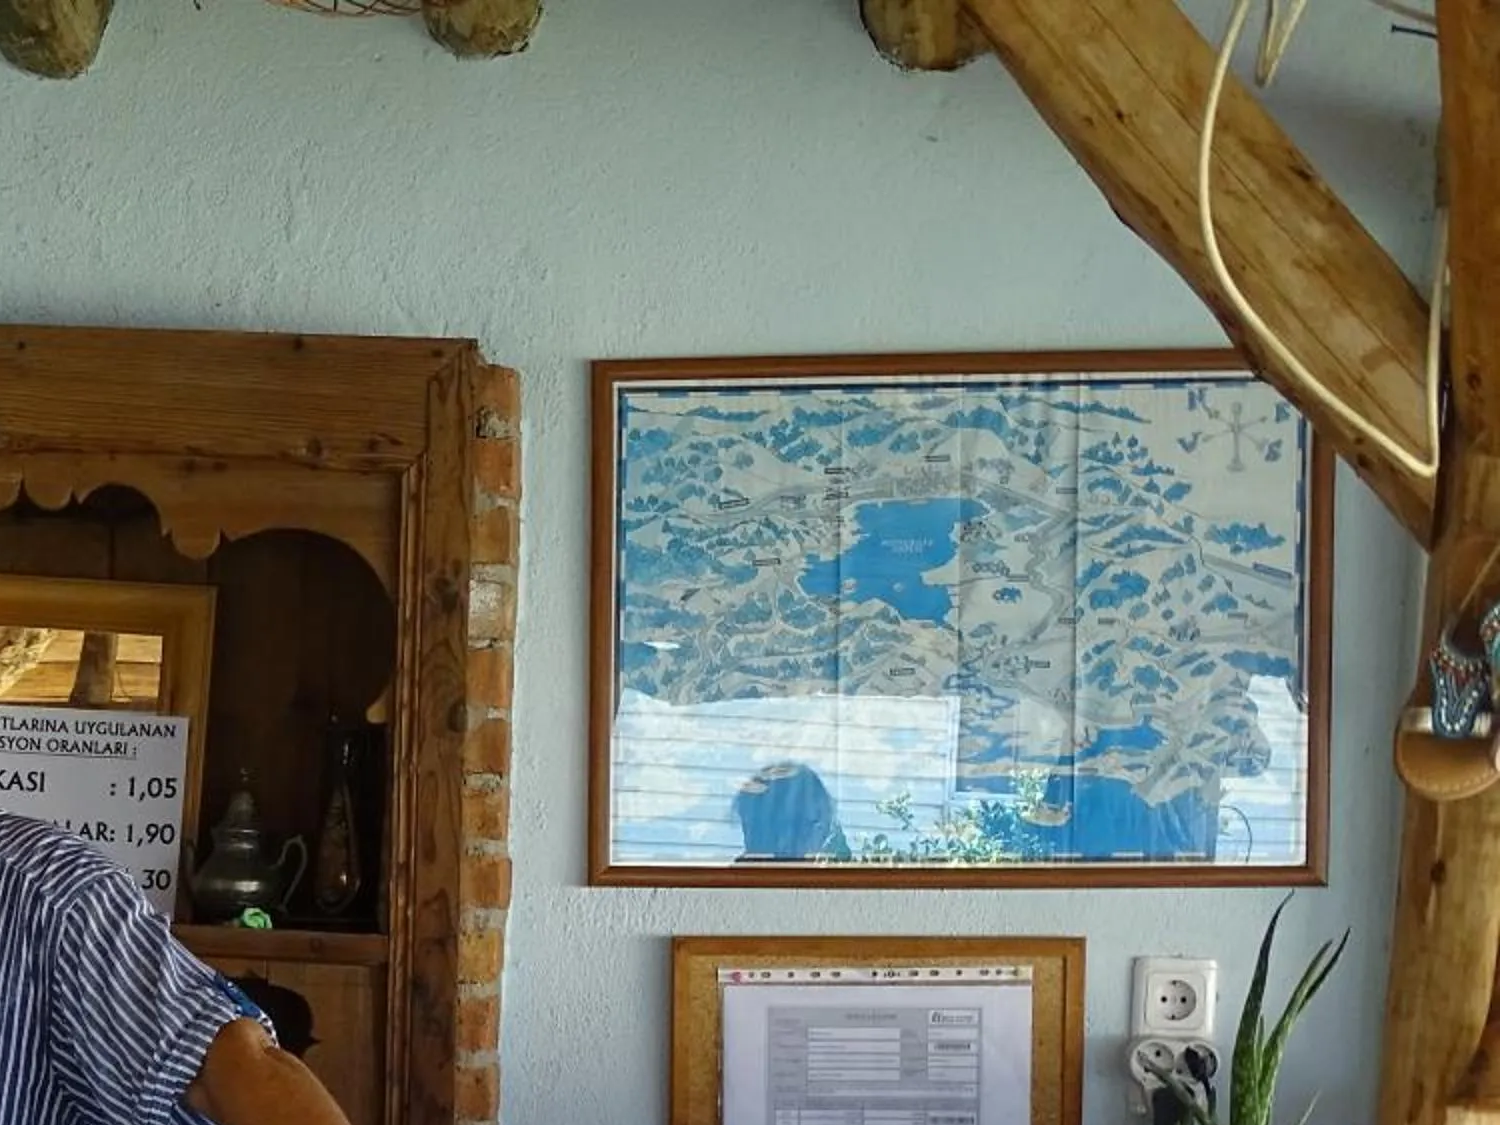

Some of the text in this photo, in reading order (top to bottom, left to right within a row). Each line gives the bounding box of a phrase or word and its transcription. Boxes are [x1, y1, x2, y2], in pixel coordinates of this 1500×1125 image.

[74, 719, 177, 738] UYGULANAN
[46, 738, 128, 756] ORANLARI
[127, 776, 178, 801] 1,05
[125, 823, 176, 847] 1,90
[140, 868, 171, 891] 30
